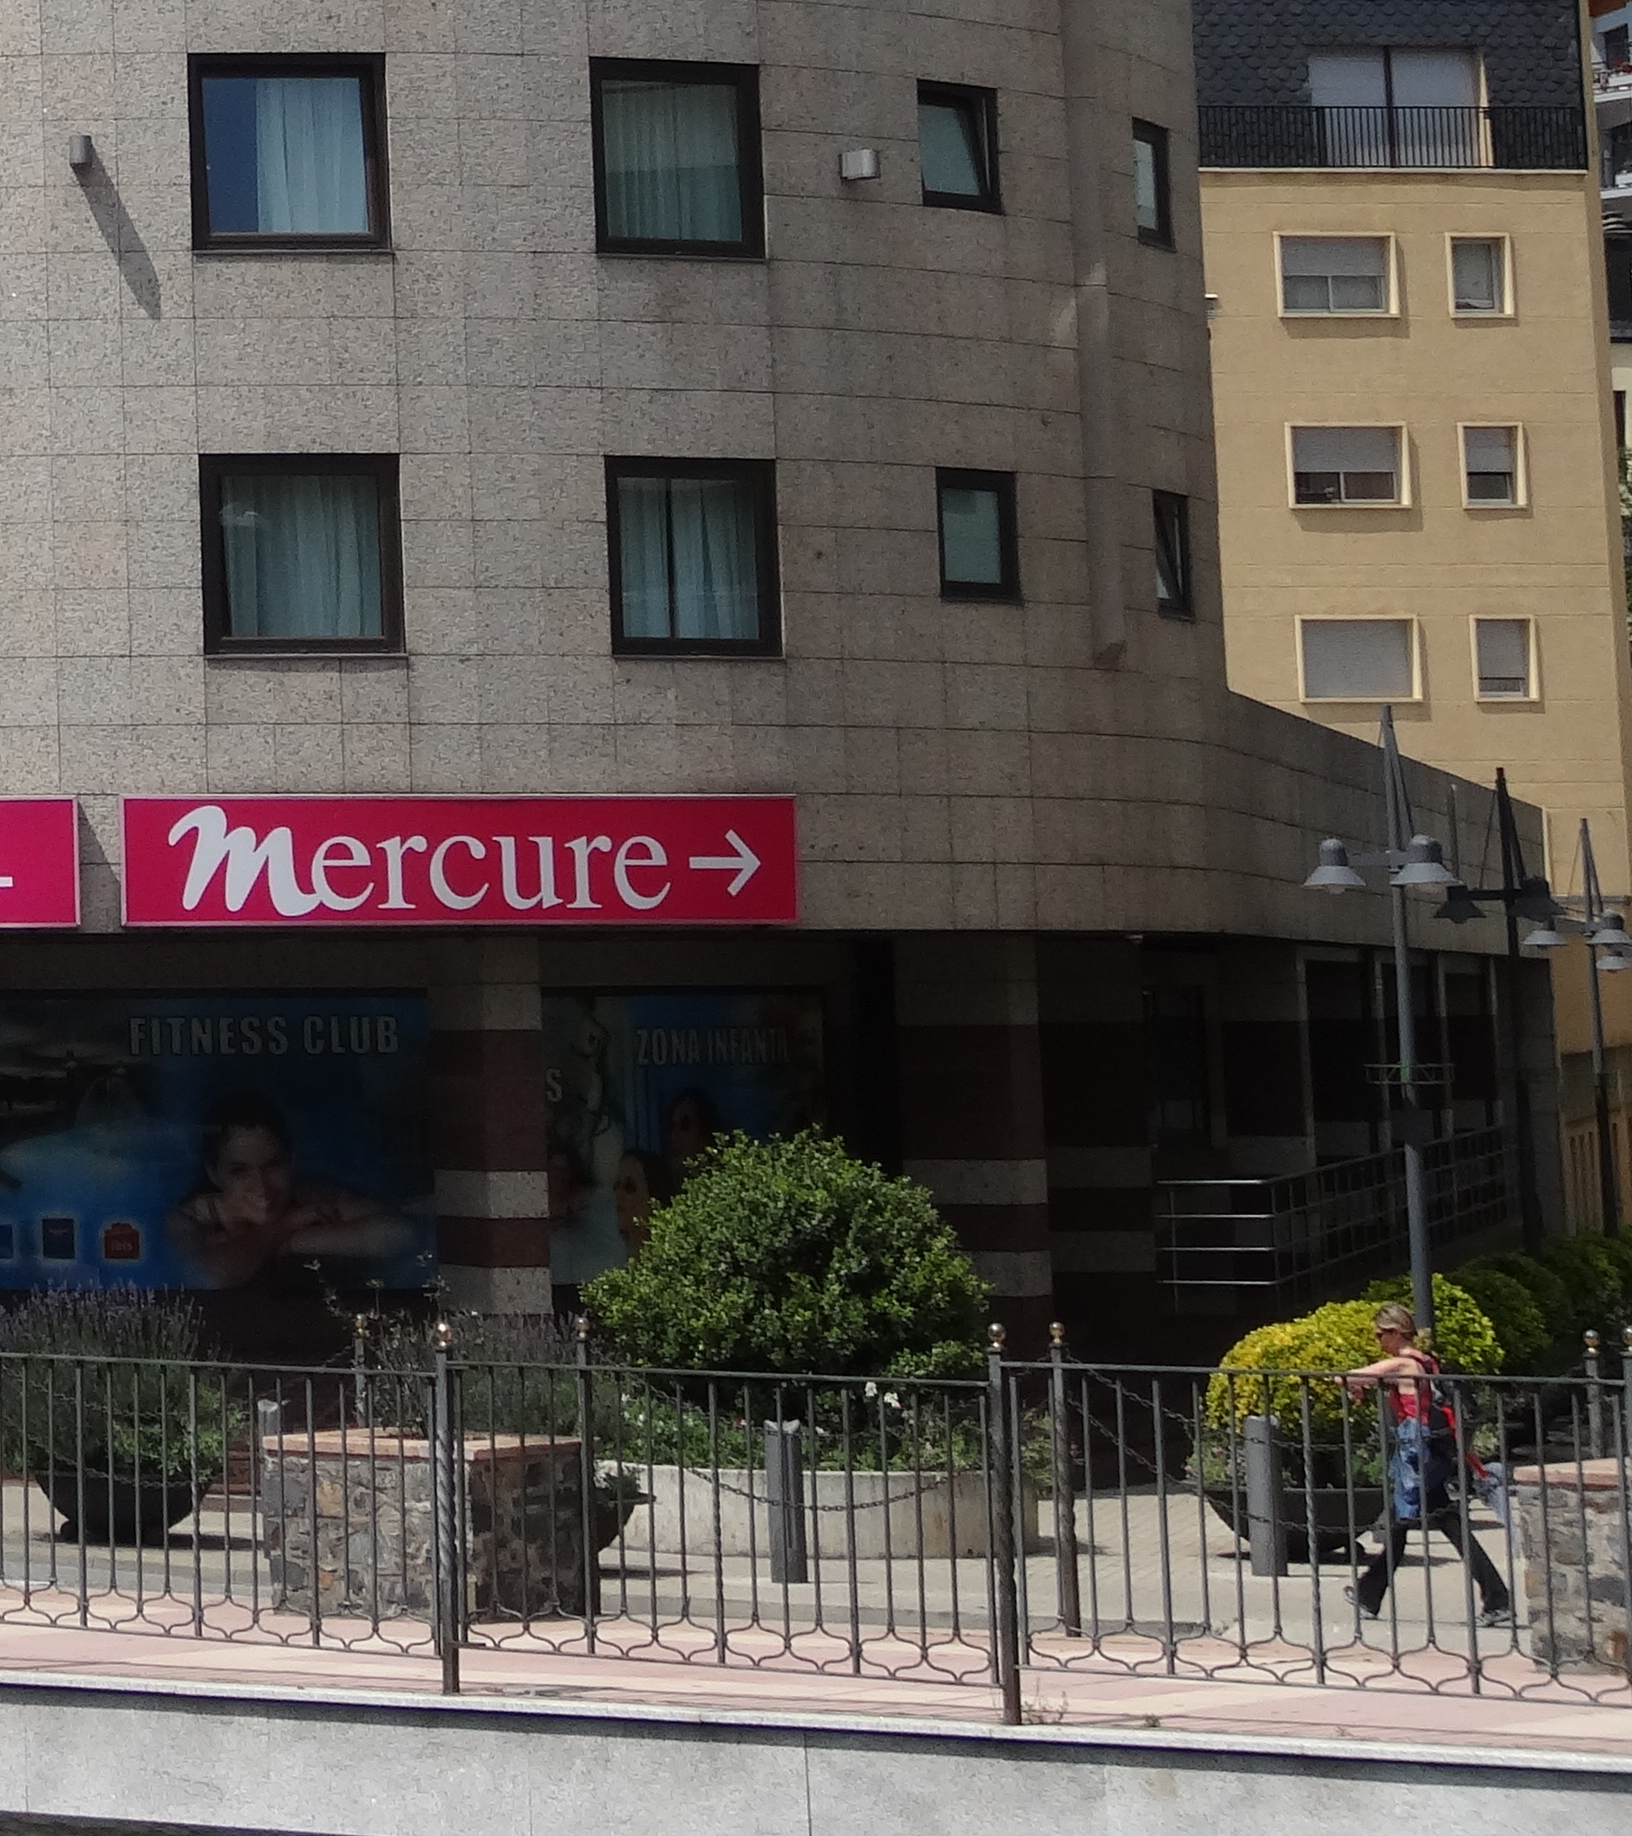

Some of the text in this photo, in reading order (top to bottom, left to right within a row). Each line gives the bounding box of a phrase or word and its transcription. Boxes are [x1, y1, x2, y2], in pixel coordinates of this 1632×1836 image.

[167, 804, 672, 918] Mercure
[128, 1013, 401, 1057] FITNESS CLUB
[634, 1027, 702, 1067] ZONA
